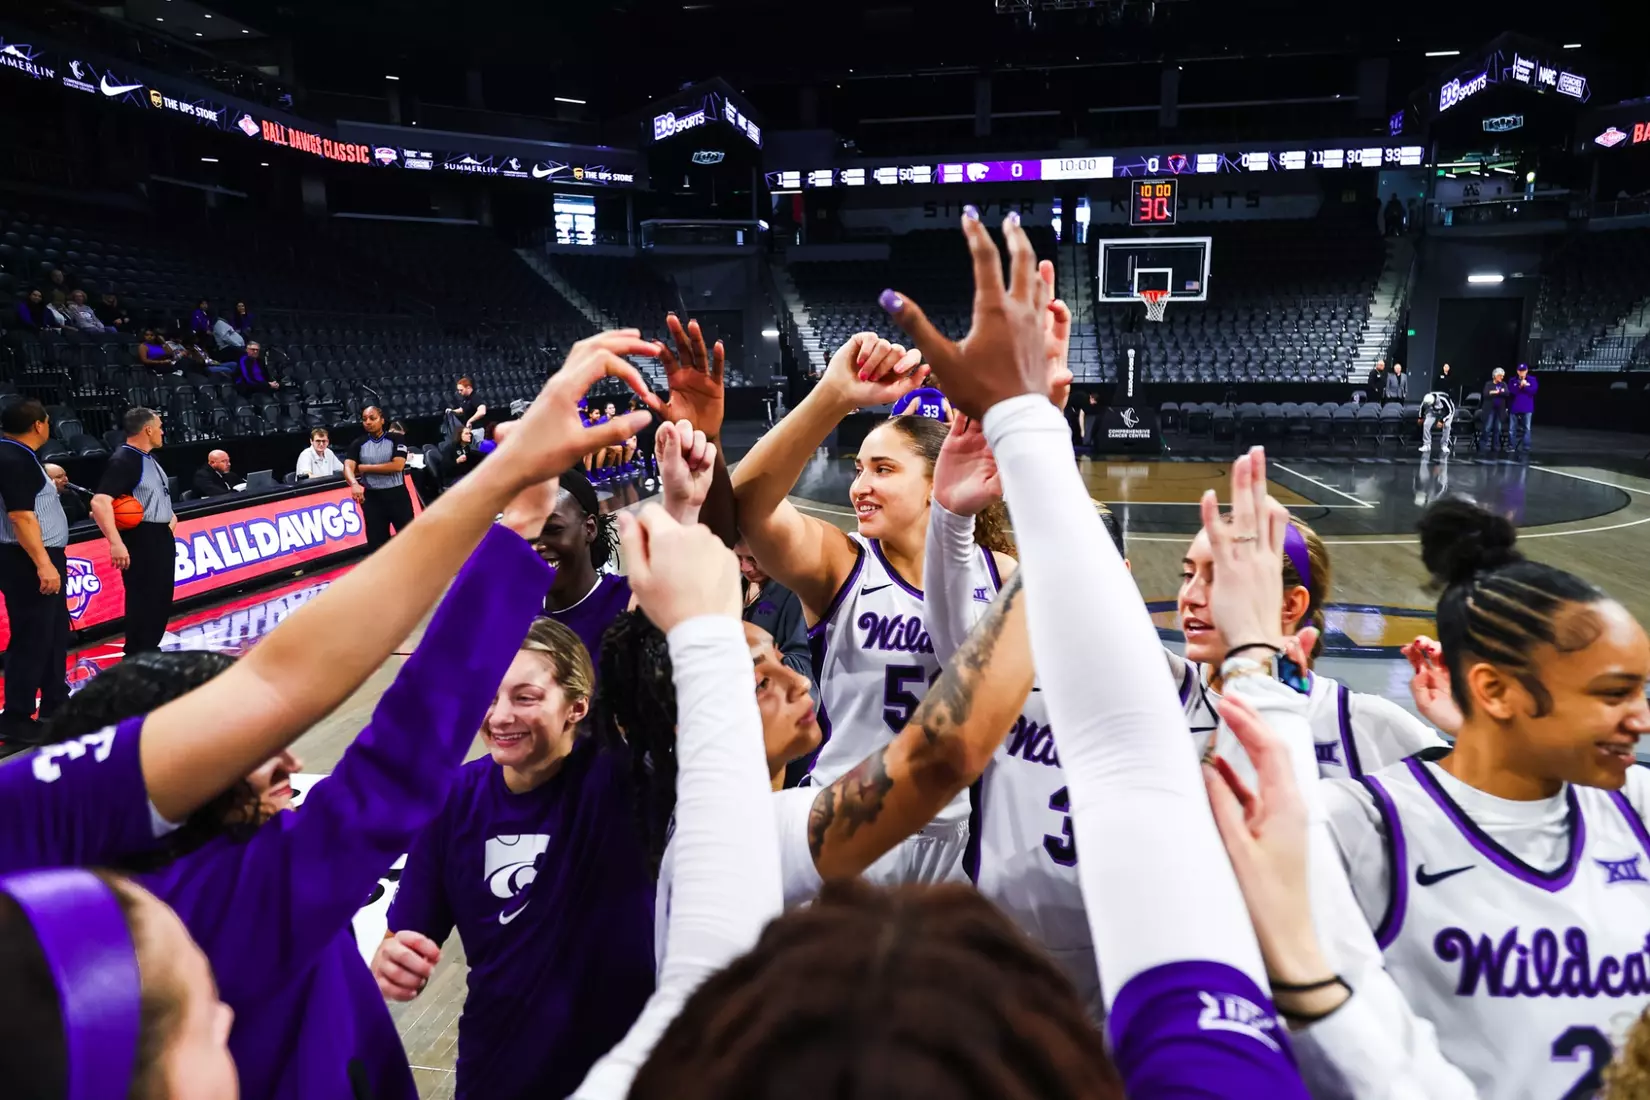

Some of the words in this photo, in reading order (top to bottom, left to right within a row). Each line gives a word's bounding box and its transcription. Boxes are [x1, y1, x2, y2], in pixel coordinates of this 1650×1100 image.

[1459, 72, 1487, 101] SPORTS
[163, 97, 178, 111] THE
[179, 101, 195, 115] UPS
[196, 105, 218, 122] STORE
[675, 112, 705, 133] SPORTS
[262, 120, 289, 146] BALL
[289, 127, 322, 155] DAWGS
[323, 138, 370, 164] CLASSIC
[1241, 154, 1249, 167] 0
[1312, 151, 1324, 165] 11
[1346, 149, 1362, 164] 30
[444, 162, 499, 174] SUMMERLIN
[1011, 163, 1022, 177] 0
[1060, 159, 1096, 171] 10:00
[1148, 158, 1159, 172] 0
[585, 170, 598, 179] THE
[613, 173, 634, 183] STORE
[808, 172, 815, 184] 2
[841, 171, 848, 183] 3
[899, 168, 914, 181] 50
[1110, 190, 1261, 212] KGHTS
[1140, 197, 1168, 221] 30
[923, 404, 940, 418] 33
[175, 502, 360, 582] BALLDAWGS
